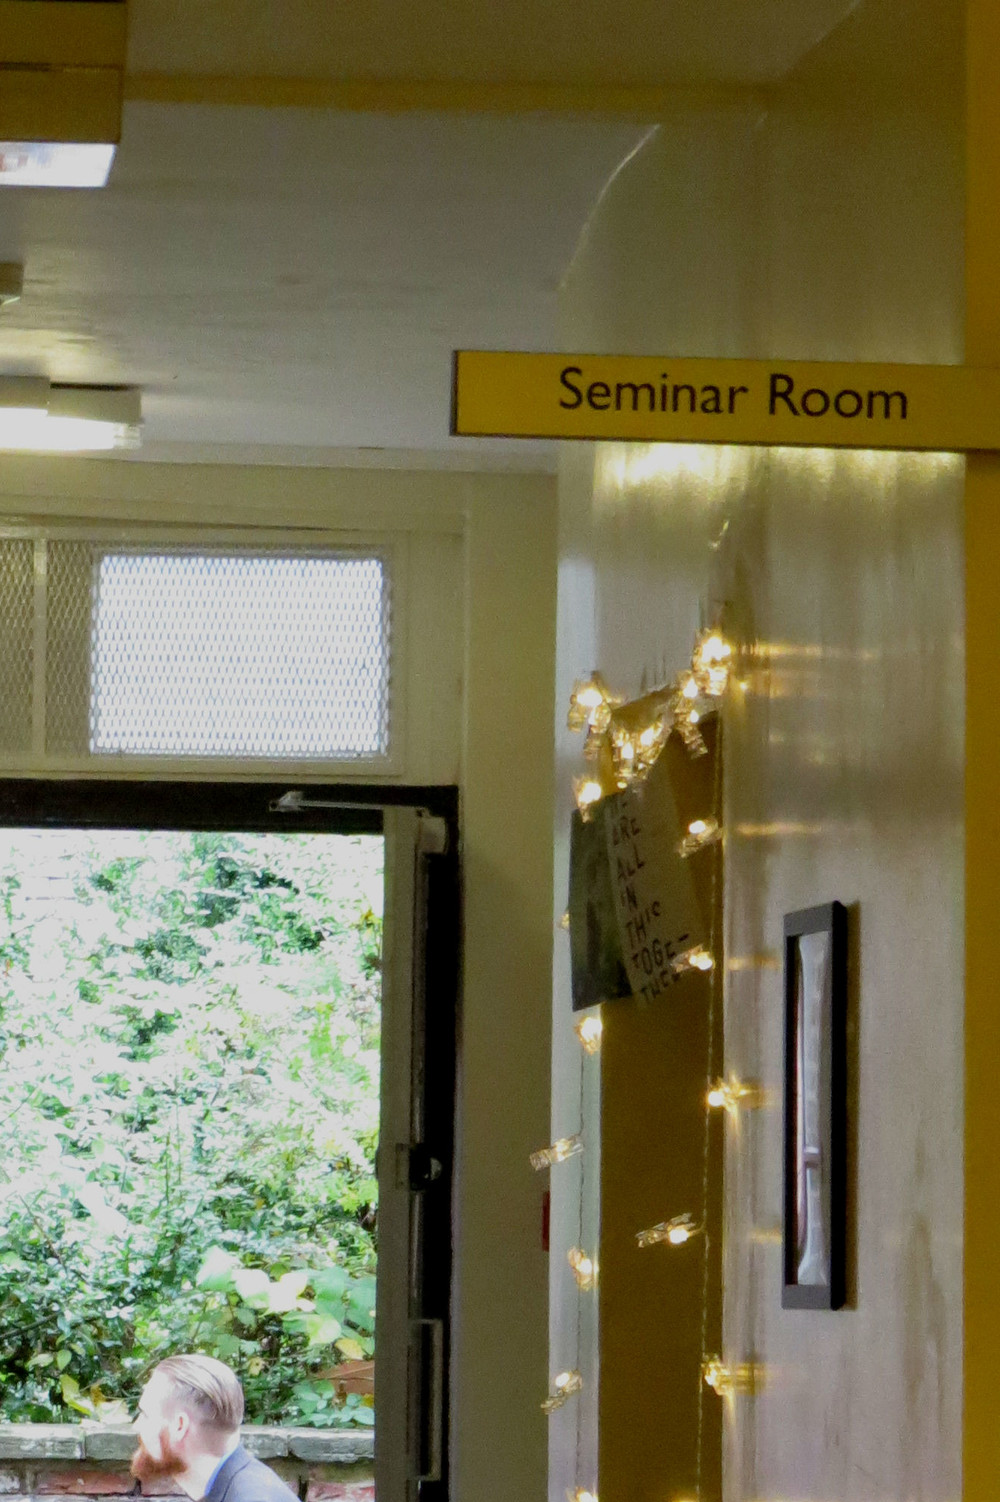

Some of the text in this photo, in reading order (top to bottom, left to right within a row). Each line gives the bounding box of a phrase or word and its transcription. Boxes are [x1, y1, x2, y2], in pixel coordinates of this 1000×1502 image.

[559, 366, 908, 419] Seminar Room
[617, 843, 645, 881] ALL
